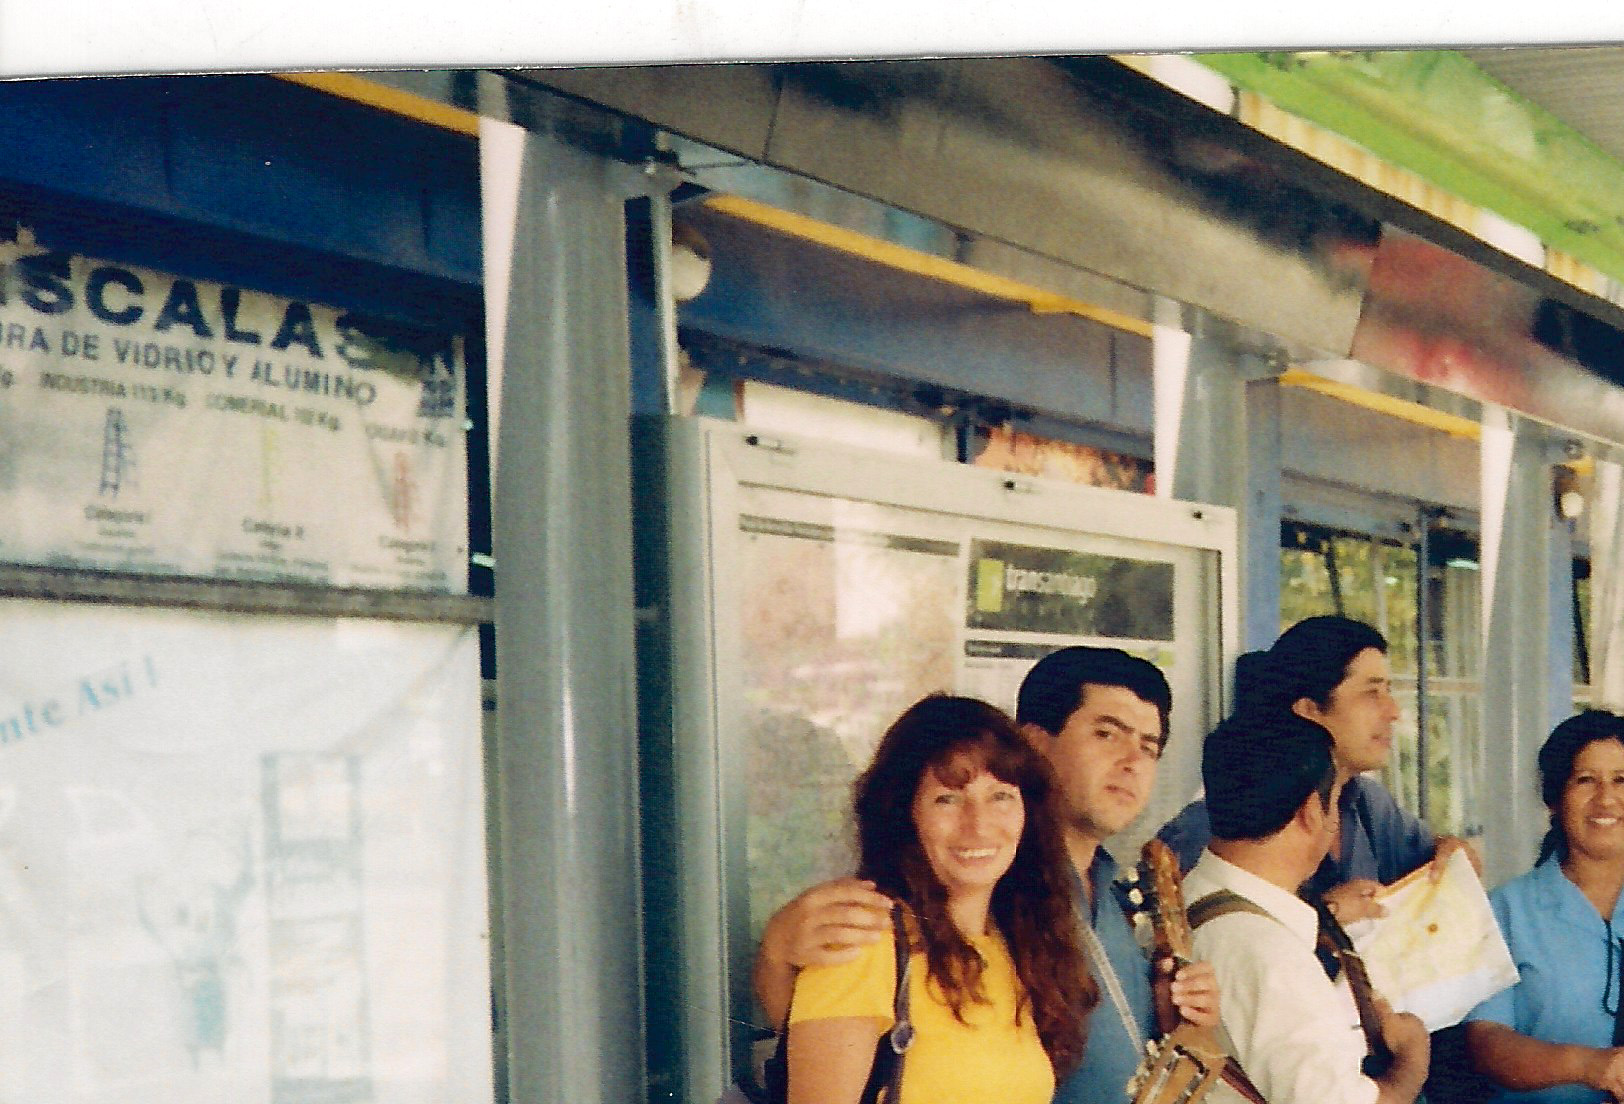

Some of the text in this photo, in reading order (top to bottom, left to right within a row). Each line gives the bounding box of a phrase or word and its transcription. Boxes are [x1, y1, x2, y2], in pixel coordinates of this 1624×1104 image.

[0, 252, 374, 372] SCALAS
[61, 330, 99, 361] DE
[114, 337, 215, 376] VIDRIO
[223, 353, 239, 378] Y
